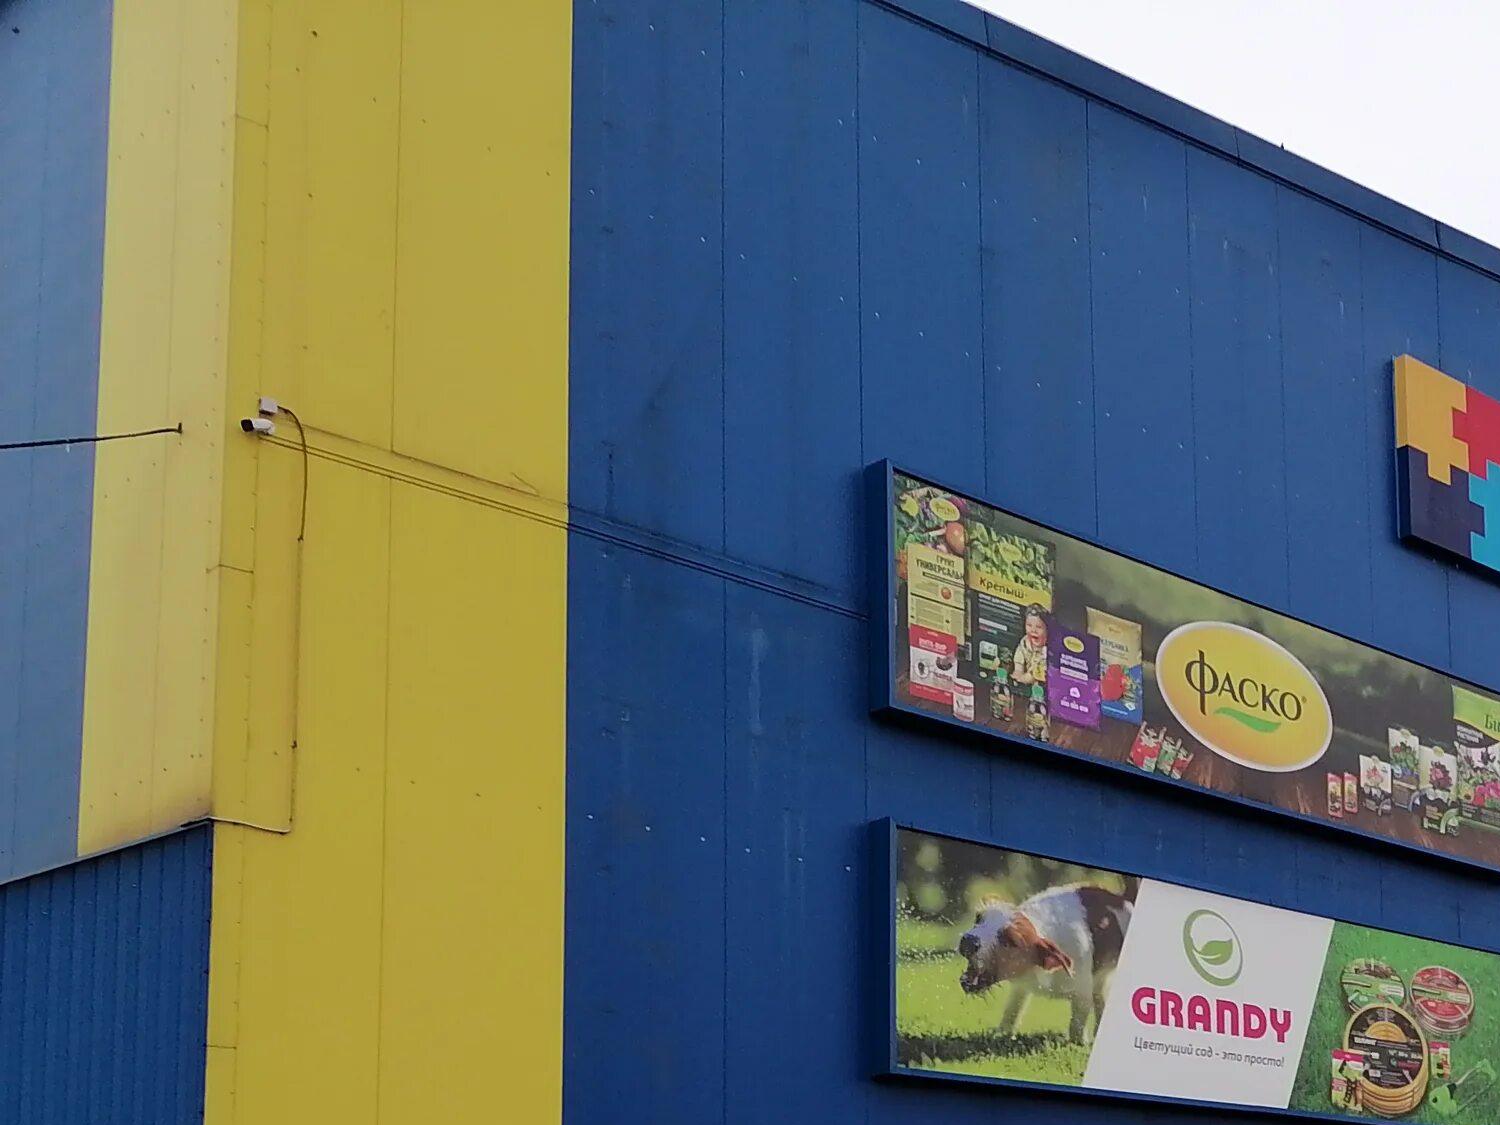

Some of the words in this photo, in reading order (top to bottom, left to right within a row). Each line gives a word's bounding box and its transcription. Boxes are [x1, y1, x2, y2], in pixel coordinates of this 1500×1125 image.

[979, 576, 1024, 599] Крепыш
[1185, 649, 1302, 721] ФАСКО
[1131, 986, 1292, 1043] GRANDY
[1134, 1036, 1194, 1057] Цветущий
[1195, 1046, 1213, 1058] сад
[1222, 1051, 1243, 1062] это
[1244, 1054, 1285, 1067] просто!
